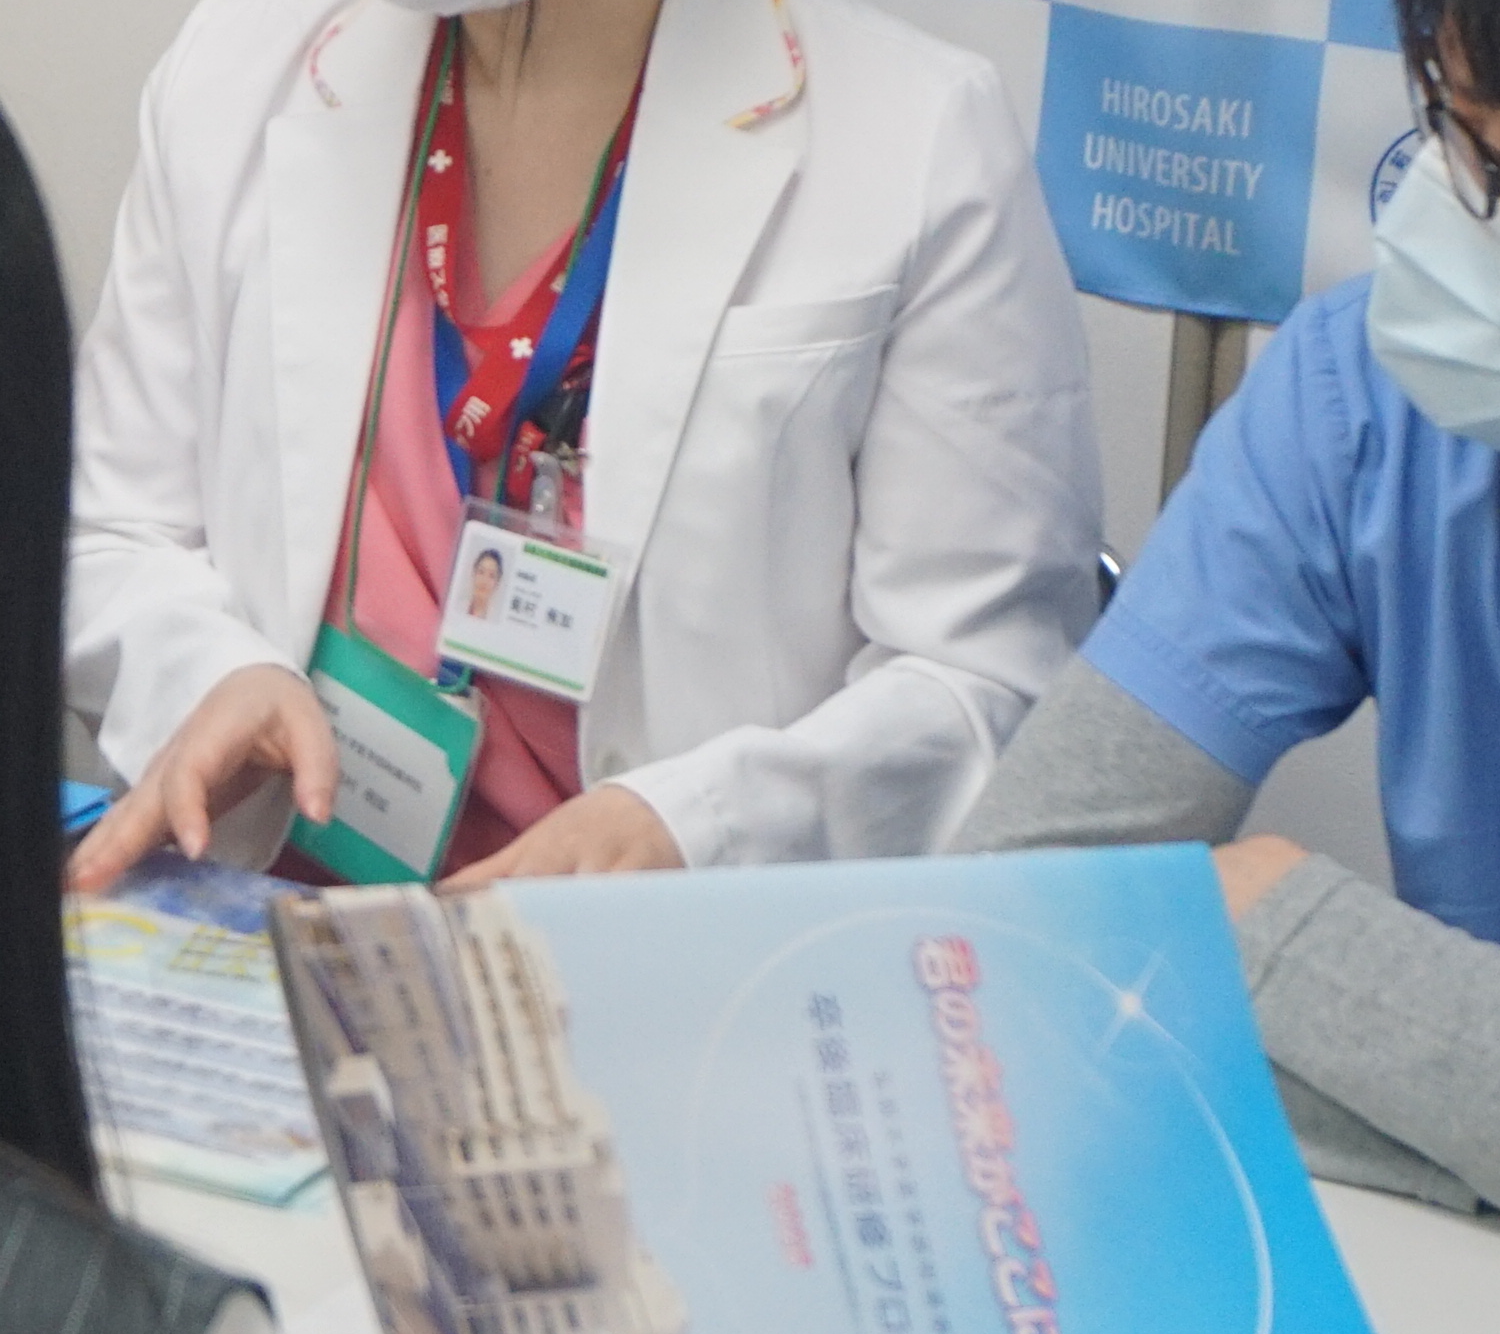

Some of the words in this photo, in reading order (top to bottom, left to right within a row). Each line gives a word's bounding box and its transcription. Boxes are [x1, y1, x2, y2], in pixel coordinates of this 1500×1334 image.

[1101, 77, 1253, 139] HIROSAKI
[1083, 132, 1264, 199] UNIVERSITY
[1090, 192, 1240, 255] HOSPITAL
